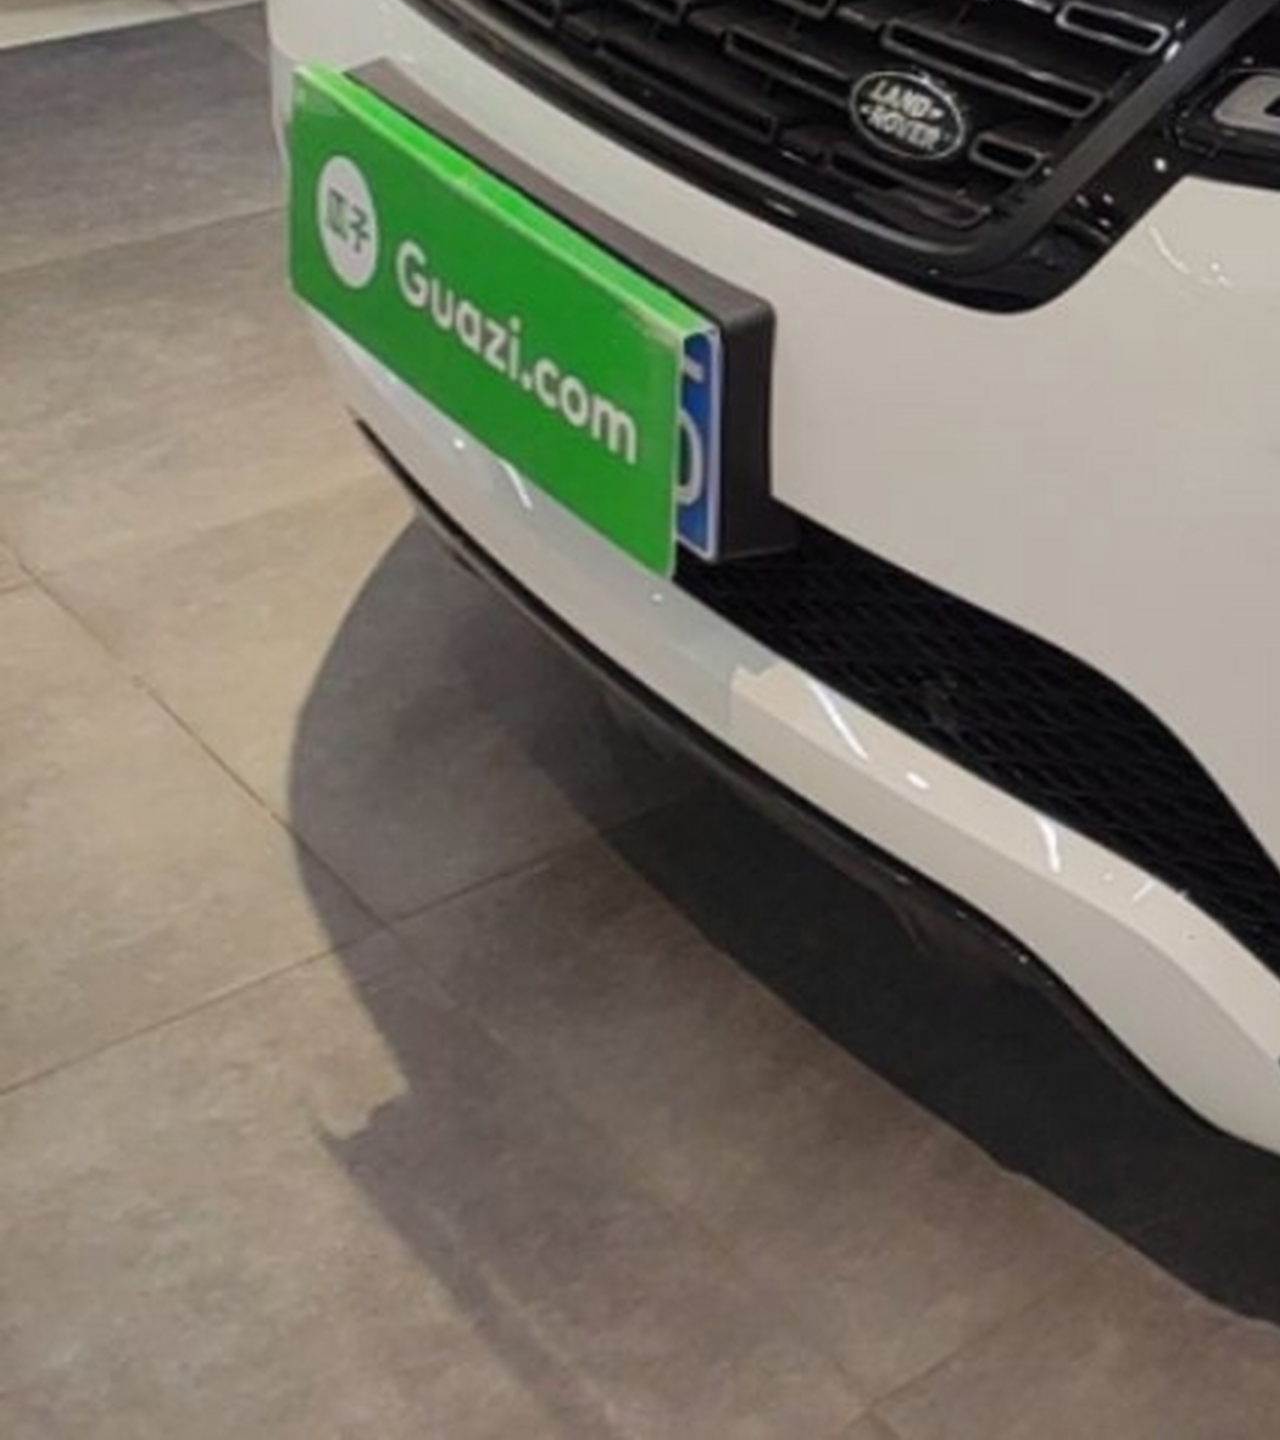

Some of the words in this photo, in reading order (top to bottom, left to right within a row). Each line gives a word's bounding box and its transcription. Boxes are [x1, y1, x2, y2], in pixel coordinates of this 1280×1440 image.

[869, 79, 933, 118] LAND
[867, 105, 941, 151] ROVER
[395, 241, 638, 465] Guazi.com
